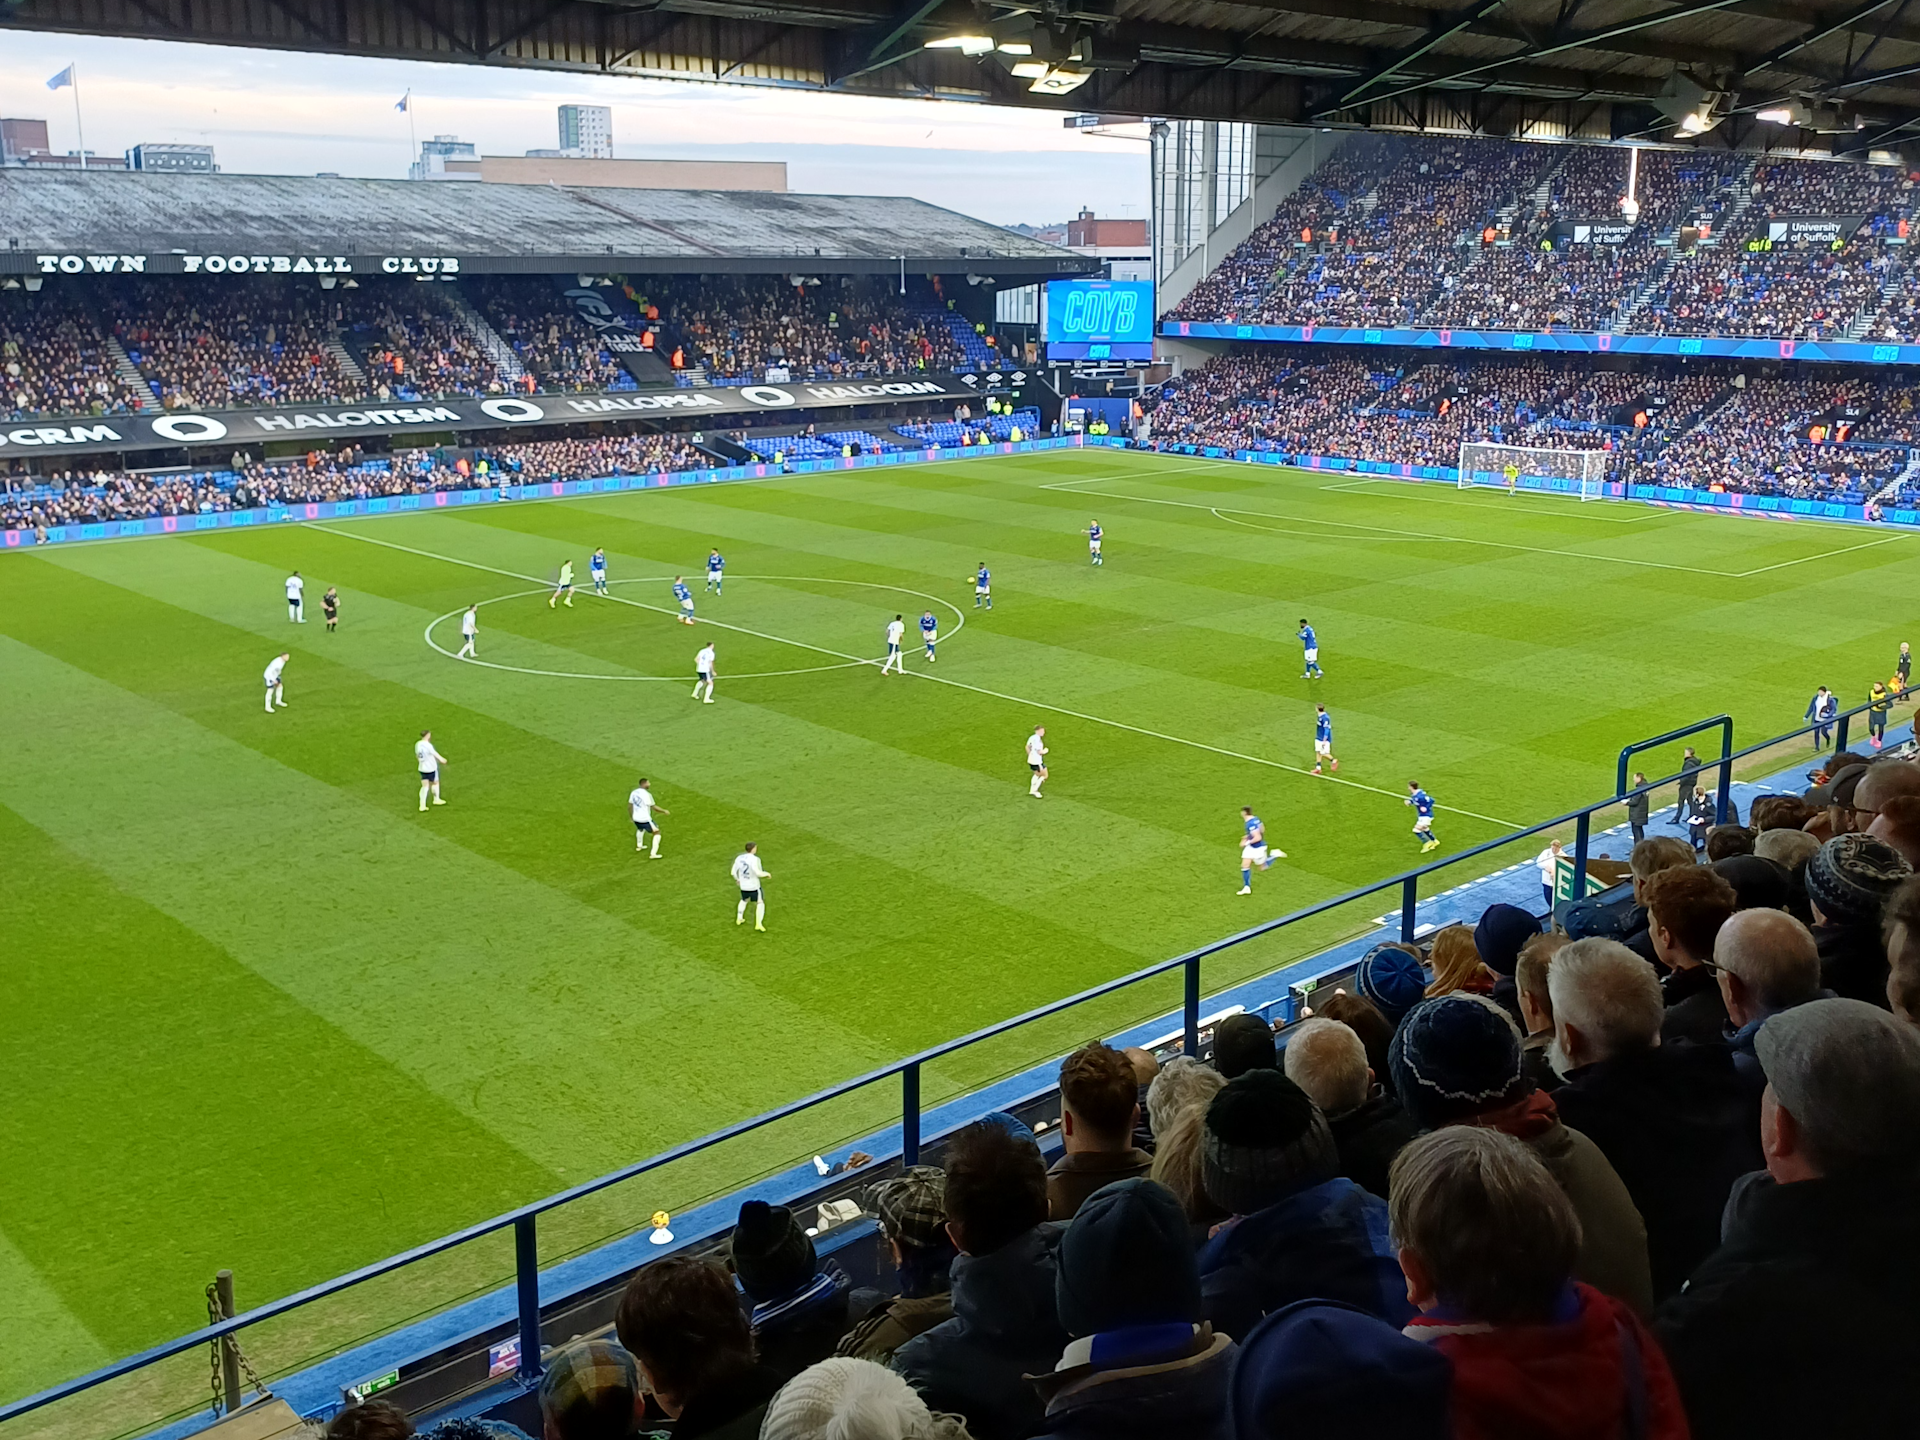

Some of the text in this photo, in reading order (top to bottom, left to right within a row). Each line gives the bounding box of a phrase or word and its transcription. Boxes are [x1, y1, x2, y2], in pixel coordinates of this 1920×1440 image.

[1791, 222, 1842, 233] University
[1593, 234, 1602, 243] of
[37, 255, 459, 273] TOWN FOOTBALL CLUB
[1063, 290, 1138, 333] COYB
[567, 393, 724, 414] HALOPSA
[254, 406, 461, 431] HALOITSM
[0, 424, 122, 446] CRM
